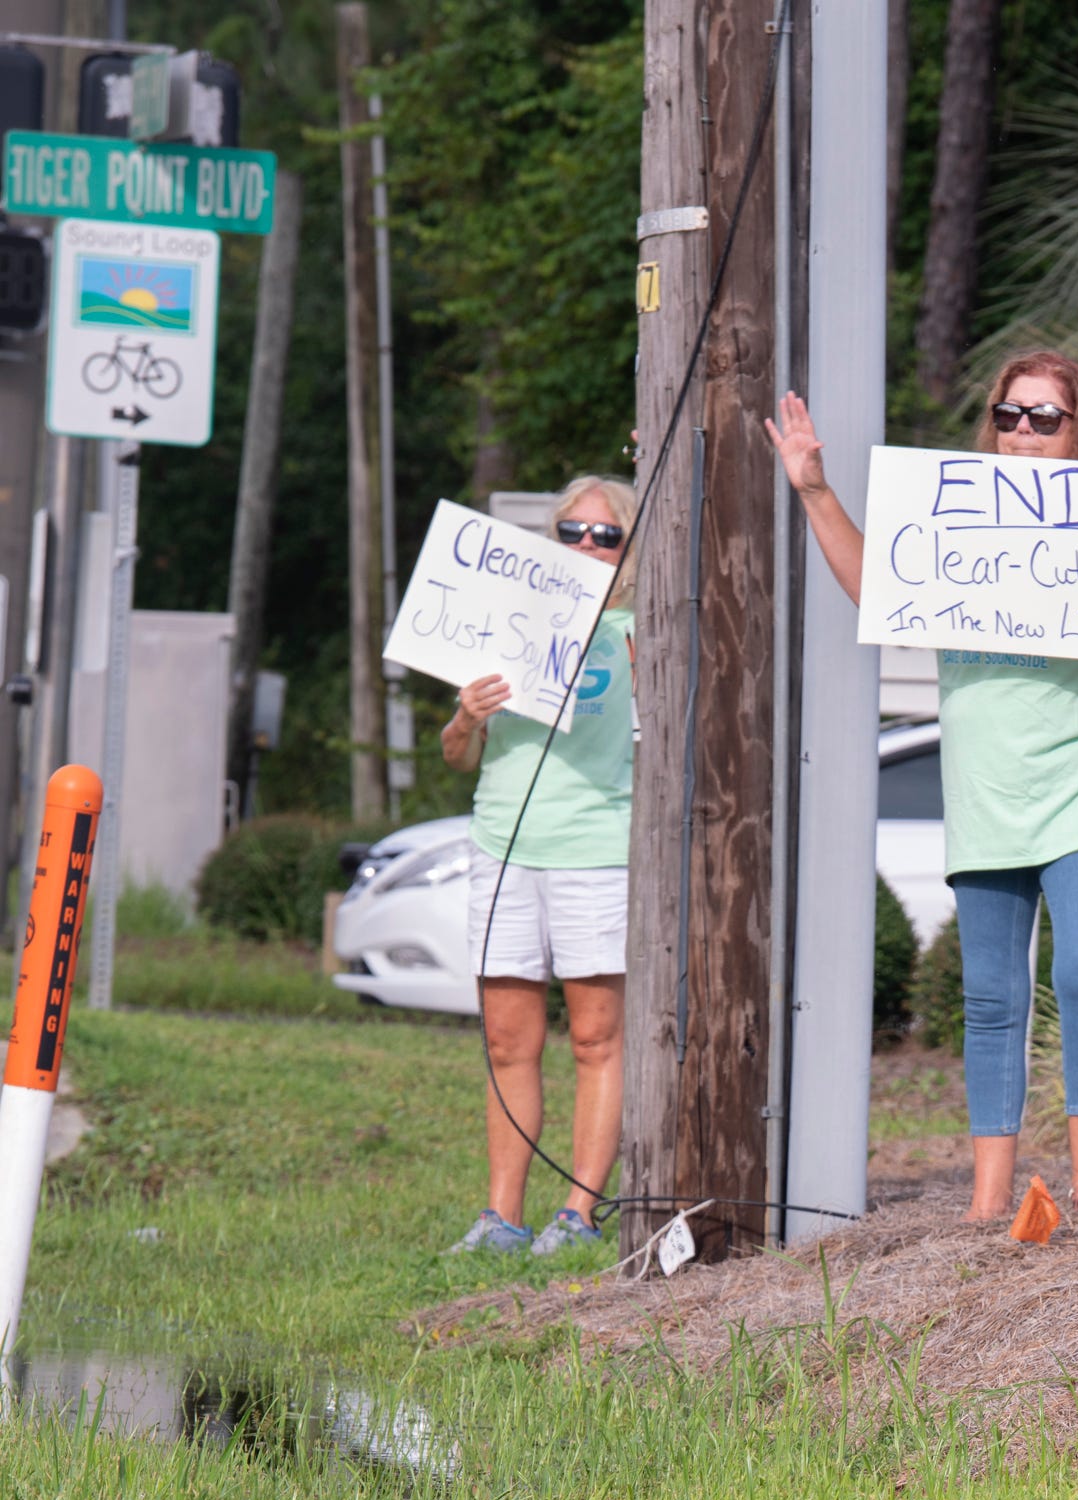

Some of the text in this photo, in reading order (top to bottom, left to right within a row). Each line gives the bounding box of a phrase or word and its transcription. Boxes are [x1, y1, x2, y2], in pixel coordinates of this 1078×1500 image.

[13, 145, 265, 220] TIGER POINT BLVD
[66, 222, 213, 259] Sound Loop
[411, 578, 494, 651] Just
[500, 612, 545, 692] Say
[887, 601, 926, 632] In
[935, 601, 986, 632] The
[995, 610, 1045, 638] New
[984, 652, 1048, 669] SOUNDSIDE
[46, 852, 84, 1033] WARNING
